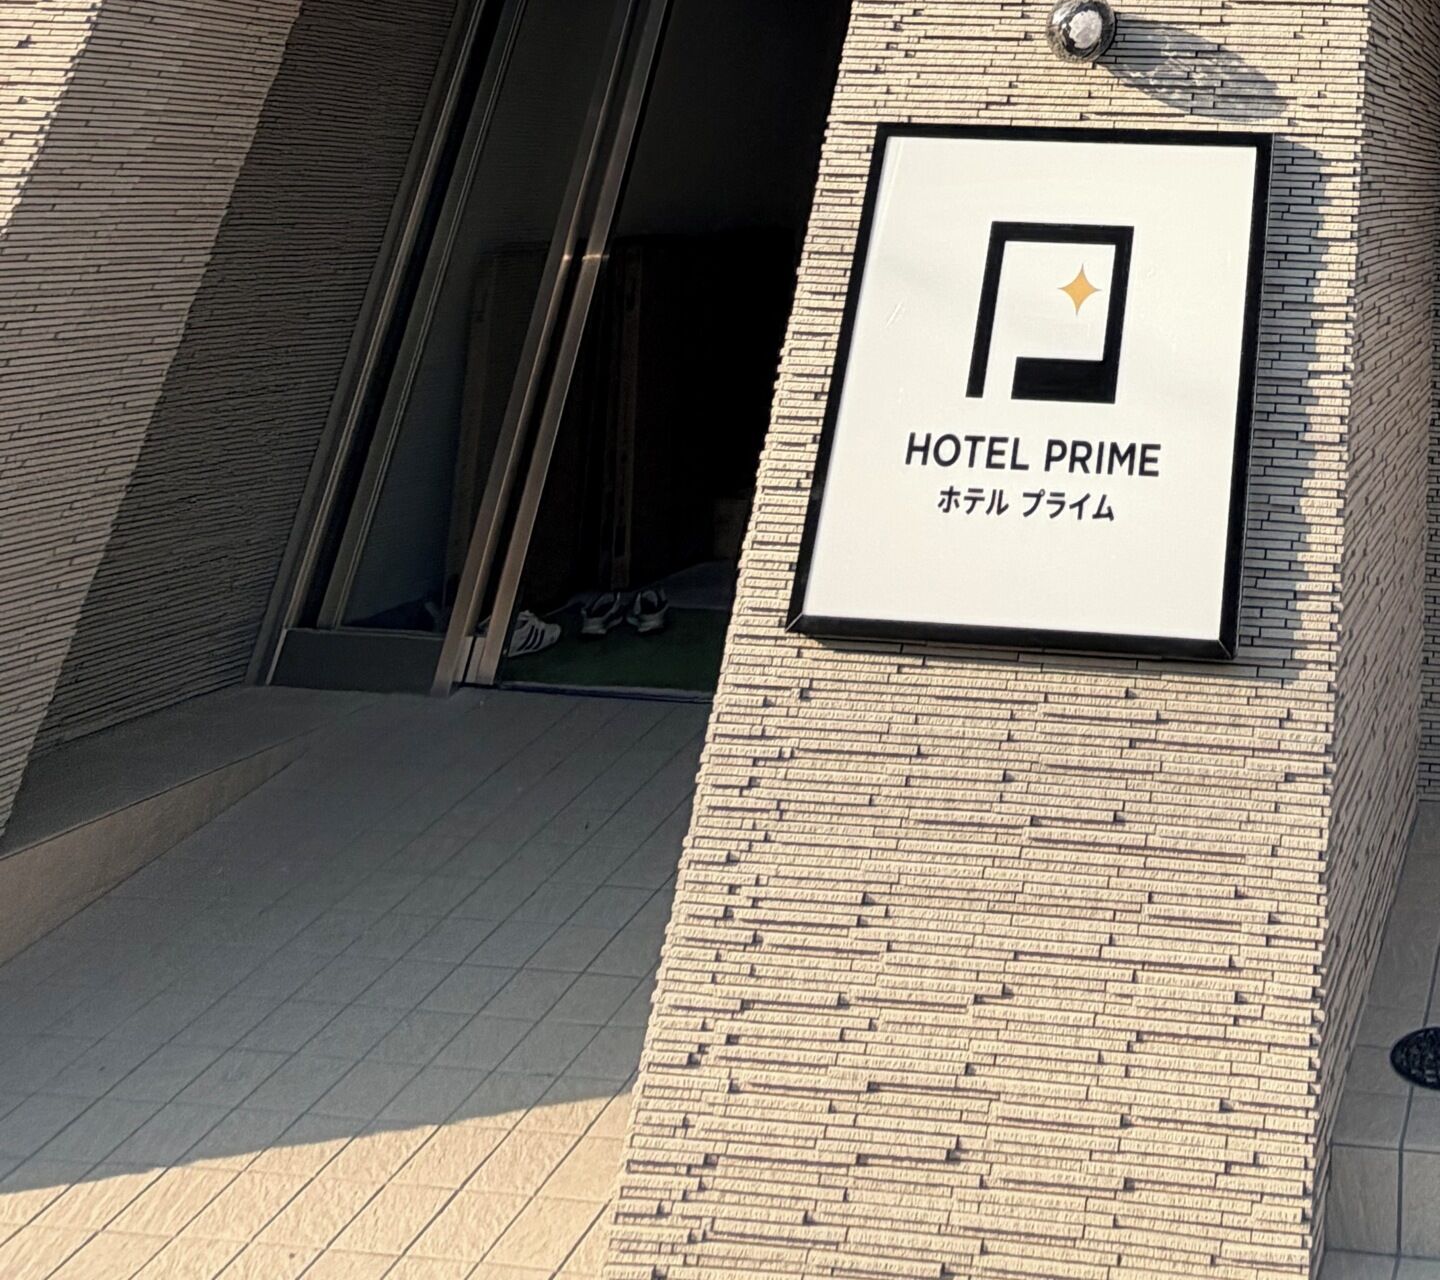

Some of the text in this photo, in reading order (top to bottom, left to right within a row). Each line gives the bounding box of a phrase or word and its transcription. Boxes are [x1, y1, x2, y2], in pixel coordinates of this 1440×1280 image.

[904, 431, 1162, 478] HOTEL PRIME
[936, 485, 1116, 522] ホテル プライム
